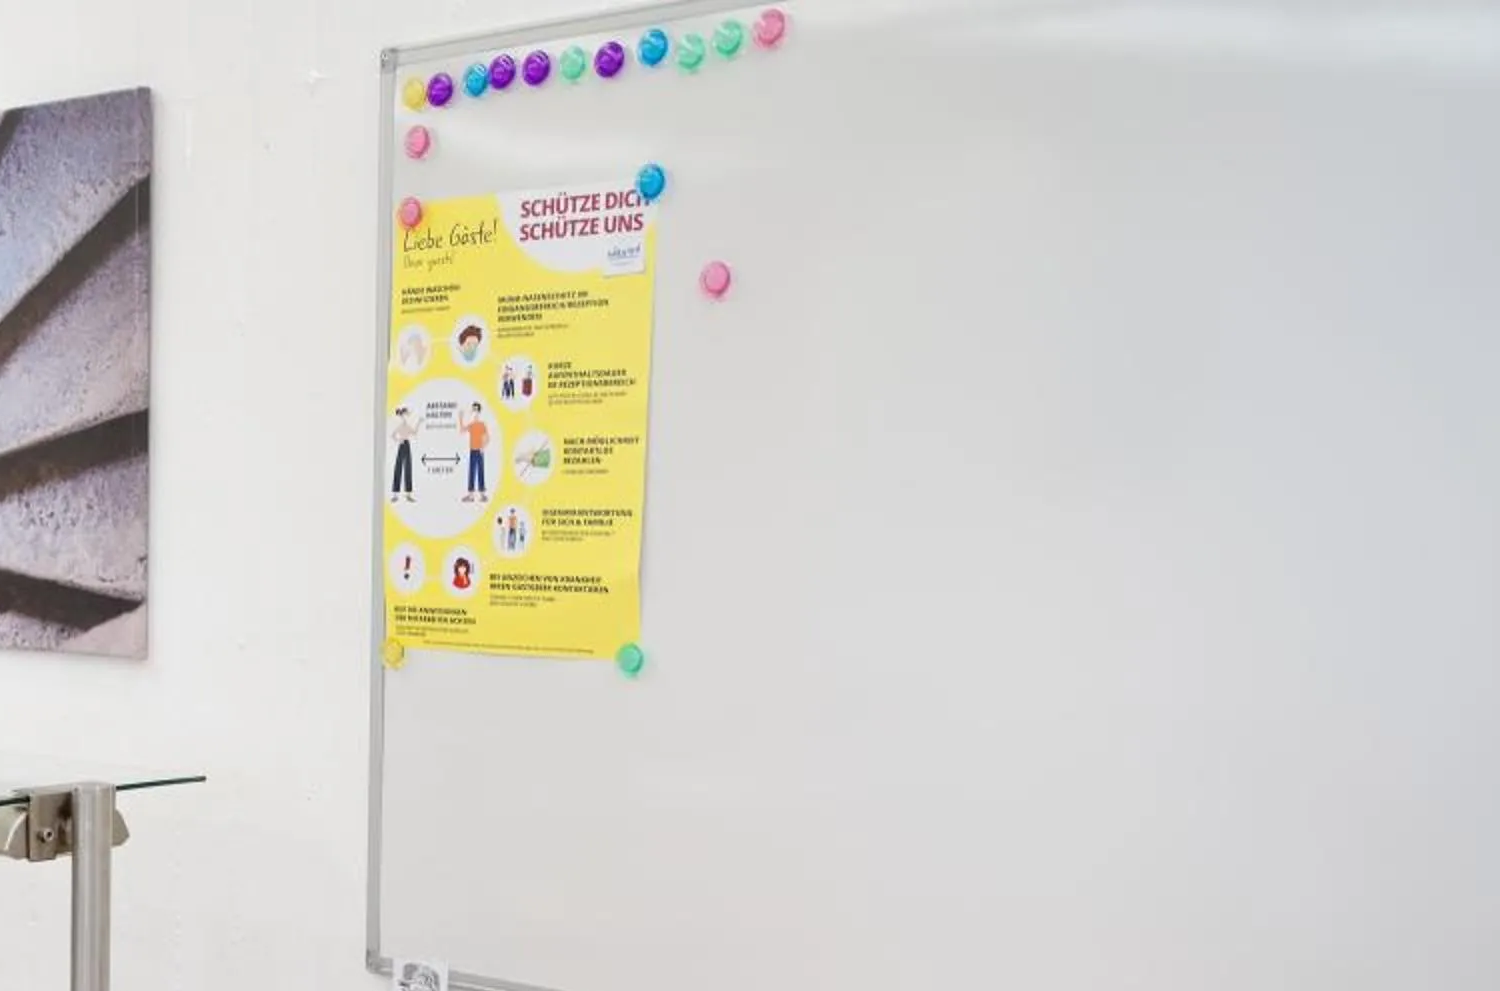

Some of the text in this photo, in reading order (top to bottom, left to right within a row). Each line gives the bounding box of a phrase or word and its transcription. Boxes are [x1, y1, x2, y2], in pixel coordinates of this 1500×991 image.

[520, 192, 600, 218] SCHÜTZE
[403, 218, 498, 252] Liebe Gäste!
[519, 212, 644, 241] SCHÜTZE UNS
